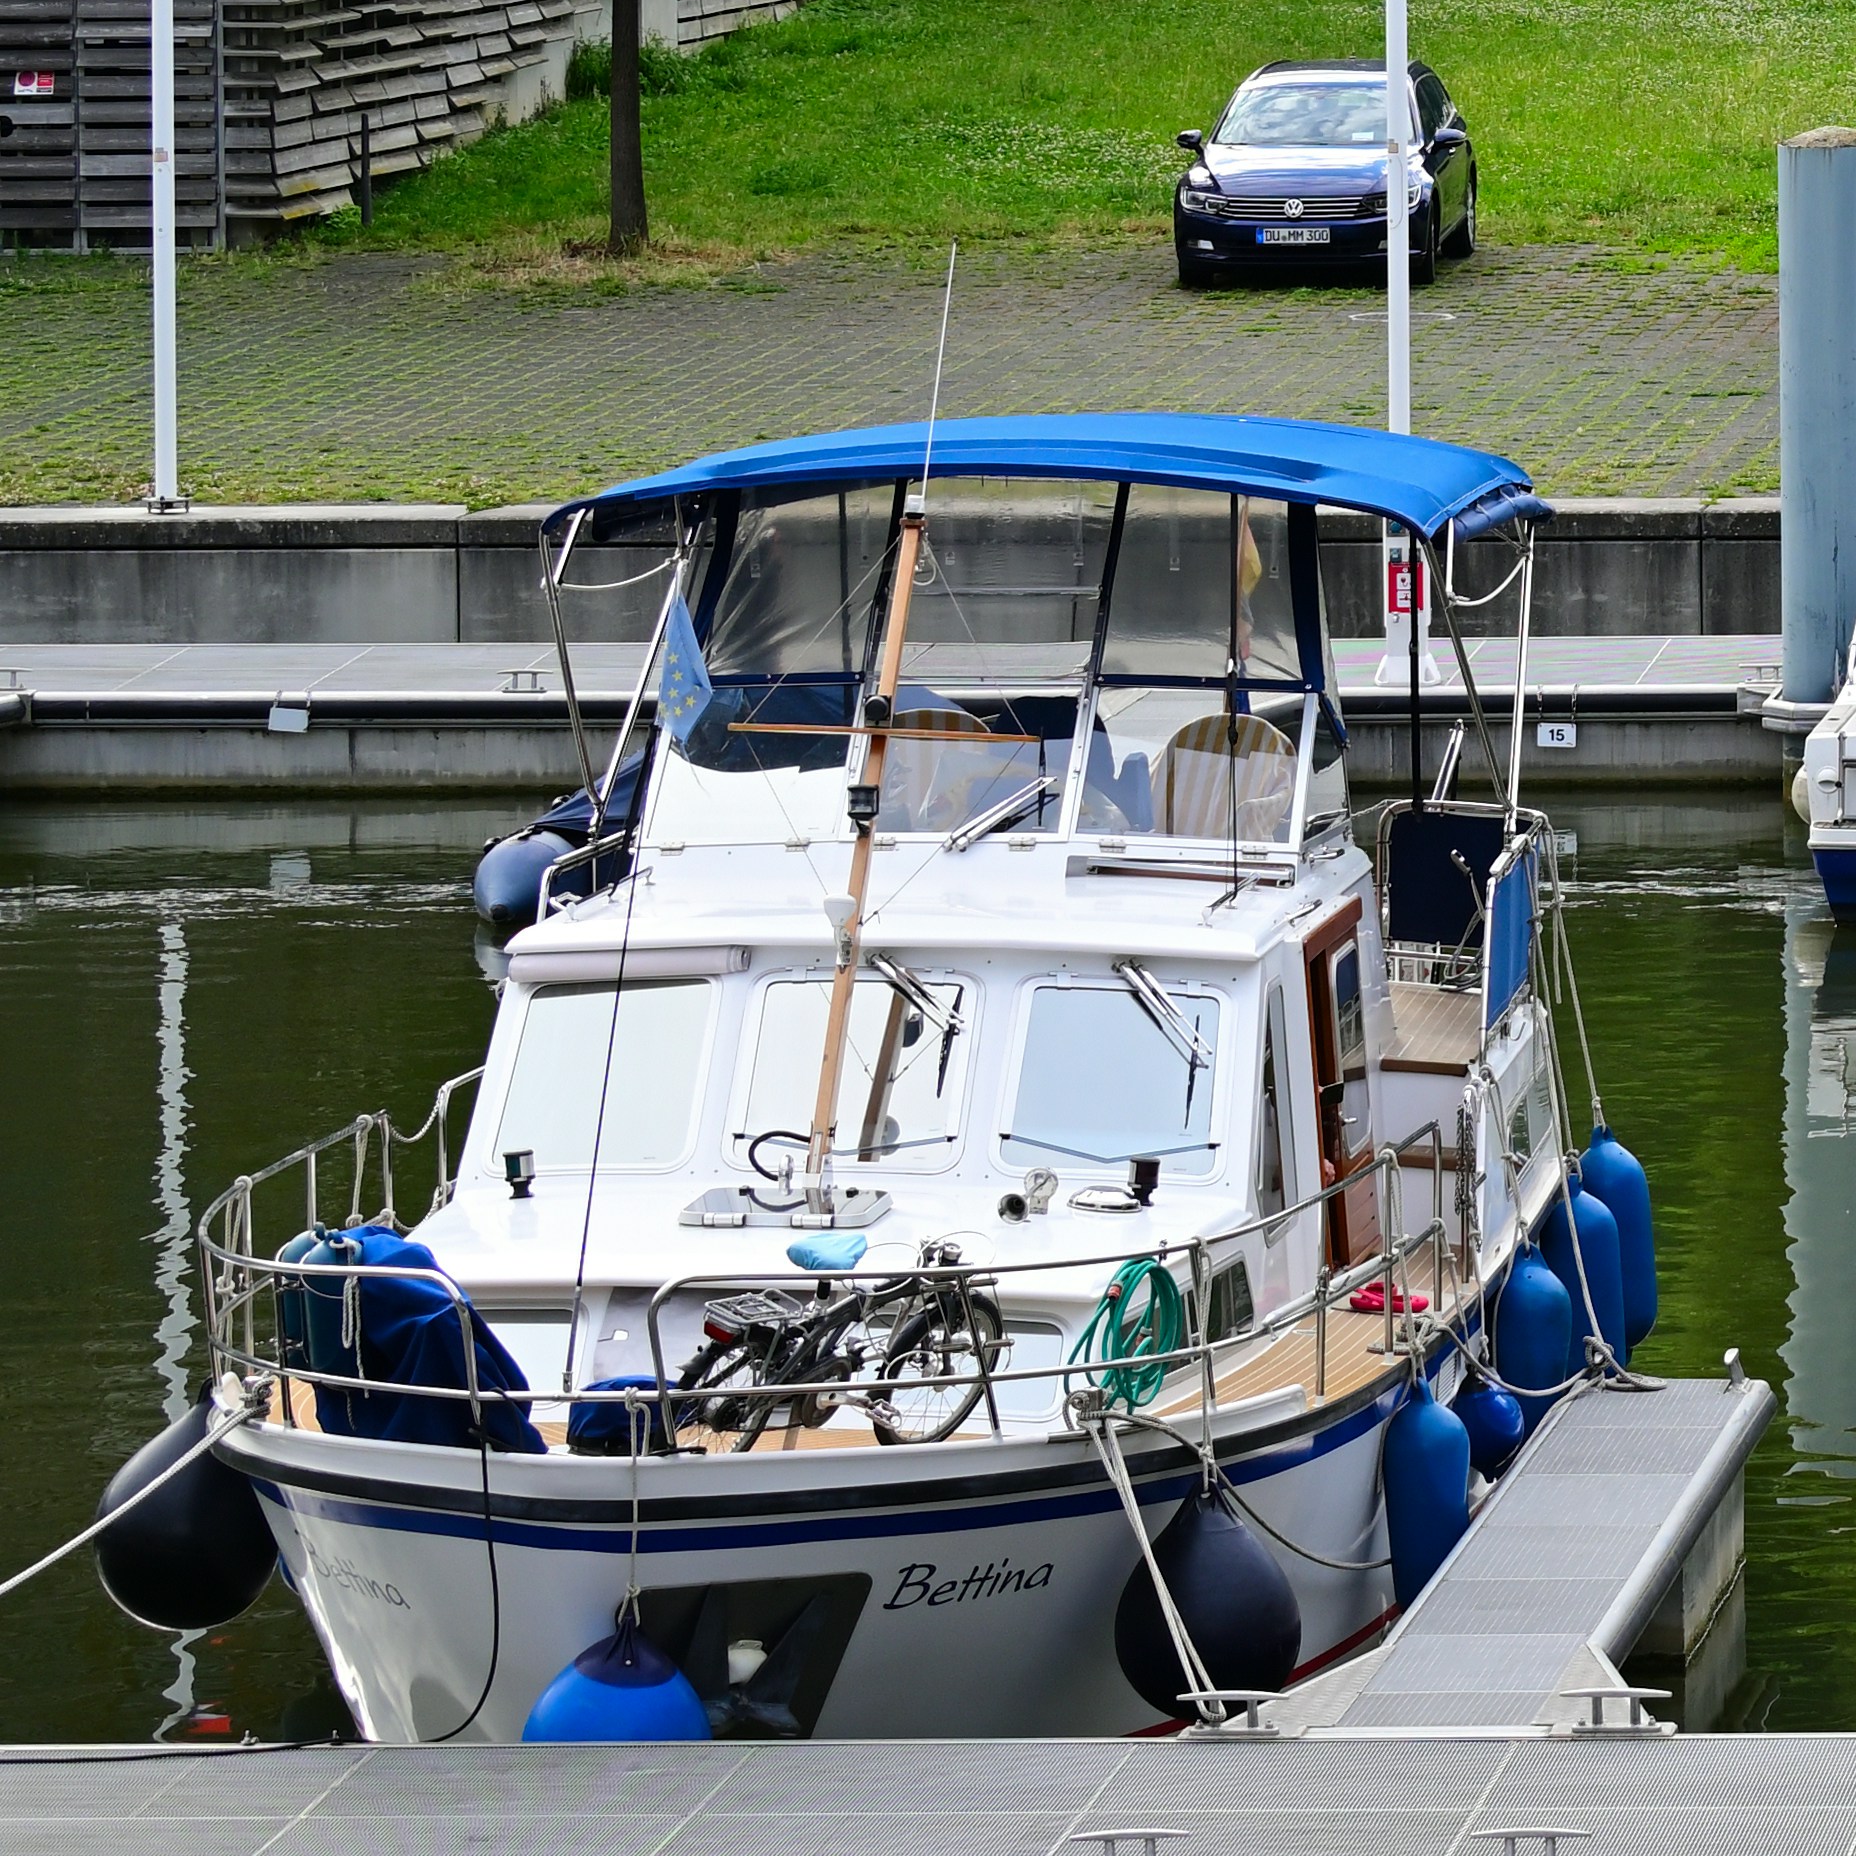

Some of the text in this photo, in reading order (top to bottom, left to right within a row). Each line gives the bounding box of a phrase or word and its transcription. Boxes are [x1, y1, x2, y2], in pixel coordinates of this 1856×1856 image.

[1264, 229, 1329, 242] DU MM 300
[1548, 728, 1565, 742] 15
[301, 1532, 411, 1610] Bettina
[882, 1557, 1055, 1611] Bettina
